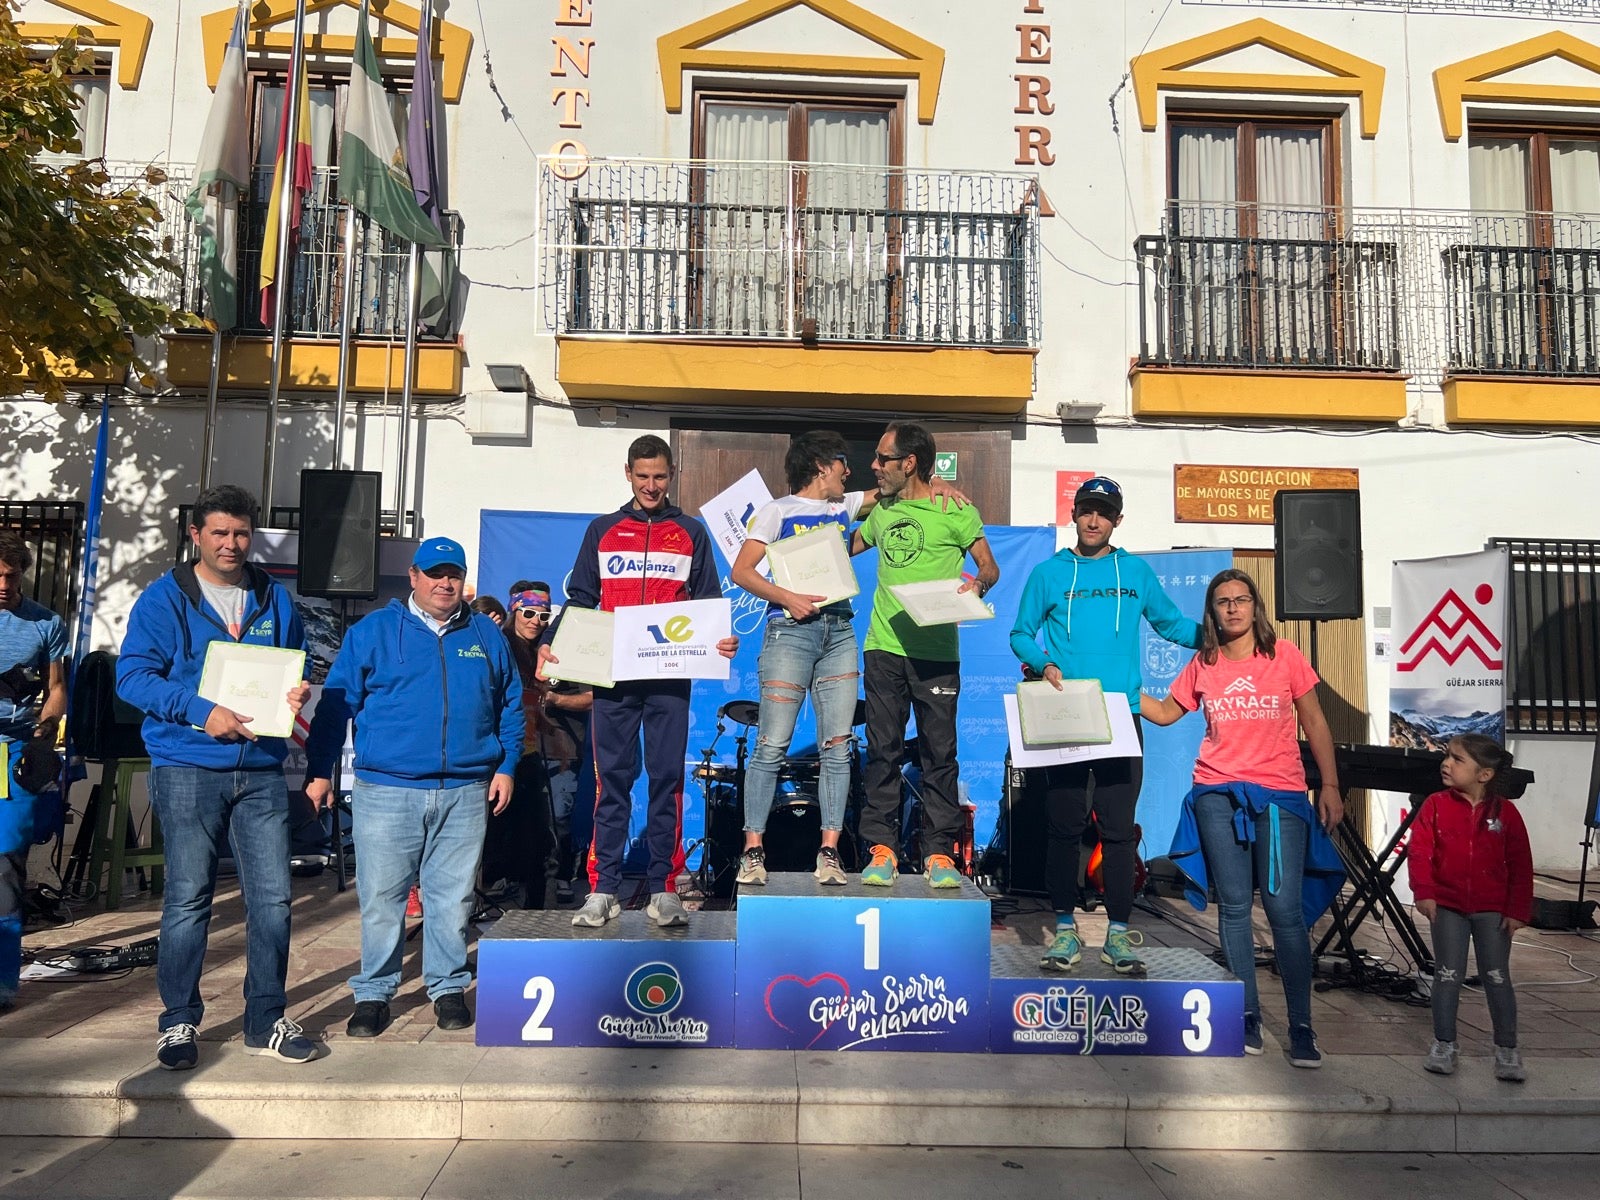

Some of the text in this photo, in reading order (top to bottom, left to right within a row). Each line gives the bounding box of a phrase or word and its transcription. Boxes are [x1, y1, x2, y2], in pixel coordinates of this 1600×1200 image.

[1218, 469, 1311, 486] ASOCIACION
[1176, 486, 1191, 498] DE
[1197, 487, 1251, 500] MAYORES
[1255, 488, 1270, 500] DE
[1207, 503, 1238, 518] LOS
[626, 559, 676, 573] Avanza
[1063, 587, 1139, 600] SCARPA
[638, 650, 660, 658] VEREDA
[1446, 677, 1504, 687] GÜÉJAR SIERRA
[1205, 695, 1279, 713] SKYRACE
[1240, 709, 1280, 721] NORTES
[855, 907, 880, 971] 1
[882, 973, 947, 1014] Sierra
[521, 976, 555, 1041] 2
[860, 994, 970, 1039] enamora
[658, 1014, 707, 1034] Sierra
[1013, 986, 1143, 1055] GÜÉJAR
[1182, 989, 1212, 1052] 3
[1014, 1031, 1147, 1045] naturaleza deporte
